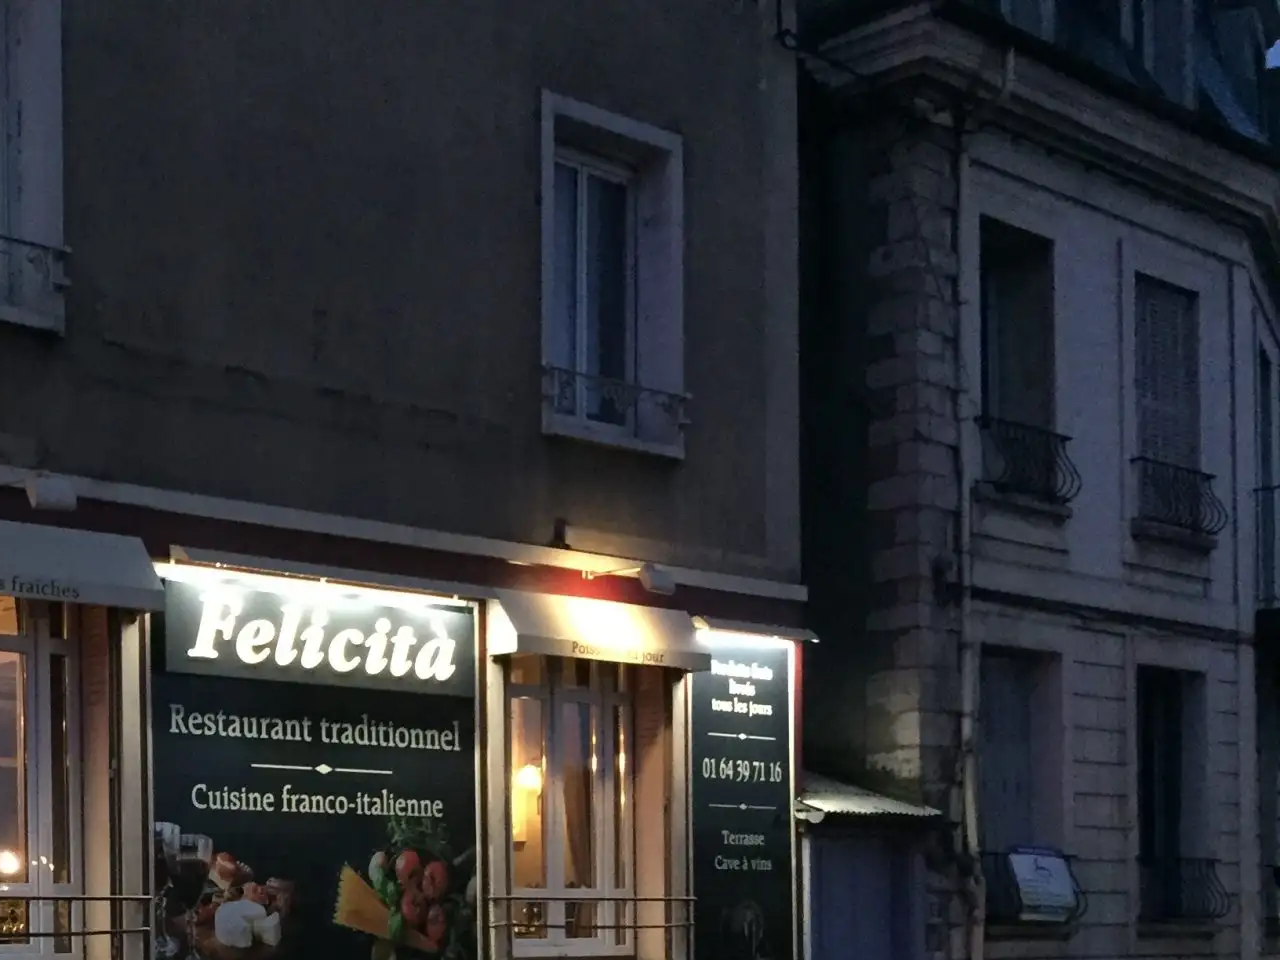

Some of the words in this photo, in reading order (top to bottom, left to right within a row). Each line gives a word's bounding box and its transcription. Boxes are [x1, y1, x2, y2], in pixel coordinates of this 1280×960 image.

[187, 592, 456, 681] Felicità
[711, 698, 733, 712] tous
[733, 697, 748, 713] les
[749, 701, 773, 717] jours
[169, 703, 312, 743] Restaurant
[320, 714, 461, 751] traditionnel
[702, 757, 716, 779] 01
[719, 757, 733, 780] 64
[736, 760, 750, 782] 39
[752, 761, 766, 782] 71
[769, 761, 782, 782] 16
[191, 783, 275, 813] Cuisine
[281, 784, 444, 818] franco-italienne
[721, 830, 765, 846] Terrasse
[714, 855, 740, 870] Cave
[742, 856, 748, 871] à
[751, 857, 772, 871] vins
